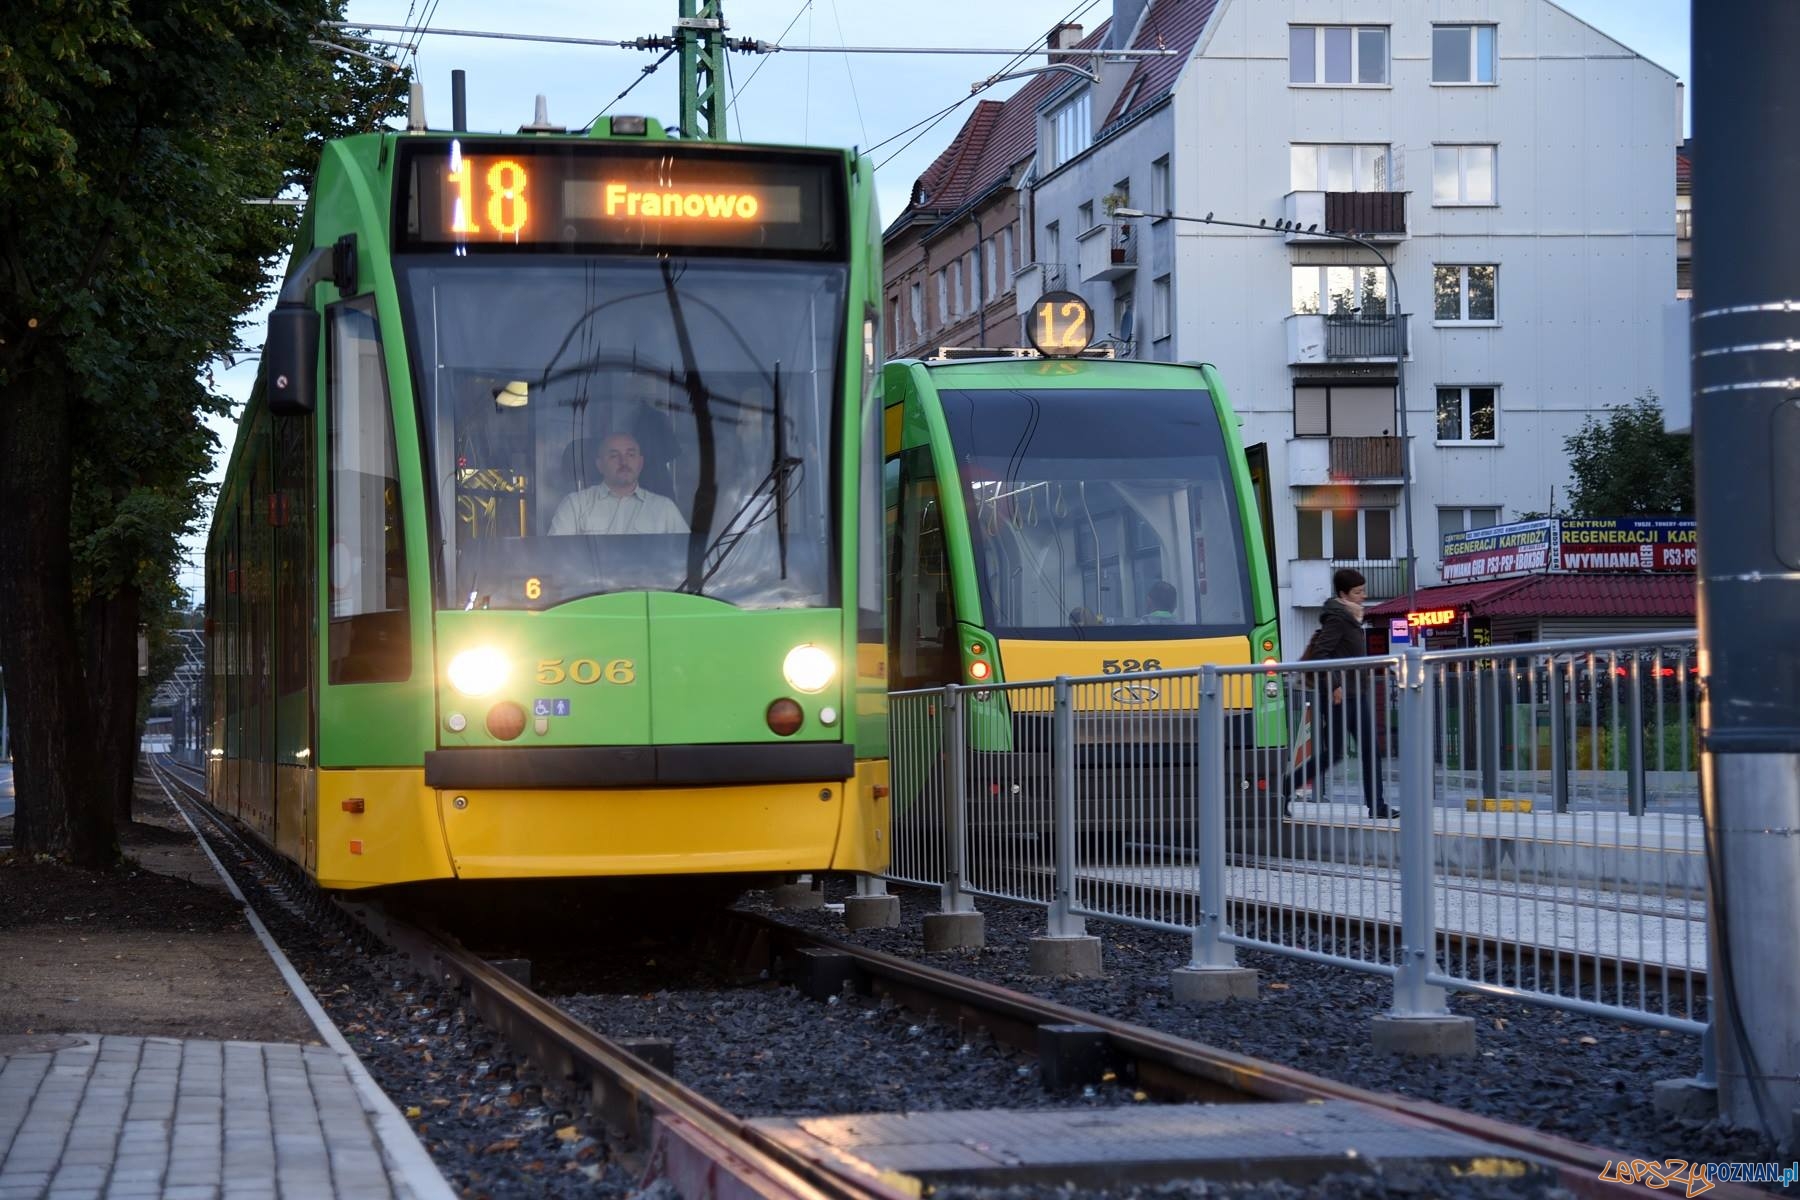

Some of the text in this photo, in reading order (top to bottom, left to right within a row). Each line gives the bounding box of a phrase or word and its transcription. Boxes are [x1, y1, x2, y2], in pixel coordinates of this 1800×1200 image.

[447, 159, 758, 234] 18 Franowo
[1039, 302, 1086, 347] 12
[1561, 520, 1617, 529] CENTRUM
[1561, 530, 1658, 543] REGENERACJI
[1444, 538, 1497, 556] REGENERACJI
[1640, 544, 1654, 568] GIER
[1564, 552, 1640, 569] WYMIANA
[525, 577, 541, 600] 6
[1407, 610, 1455, 627] SKUP
[536, 657, 636, 685] 506
[1102, 658, 1162, 675] 526
